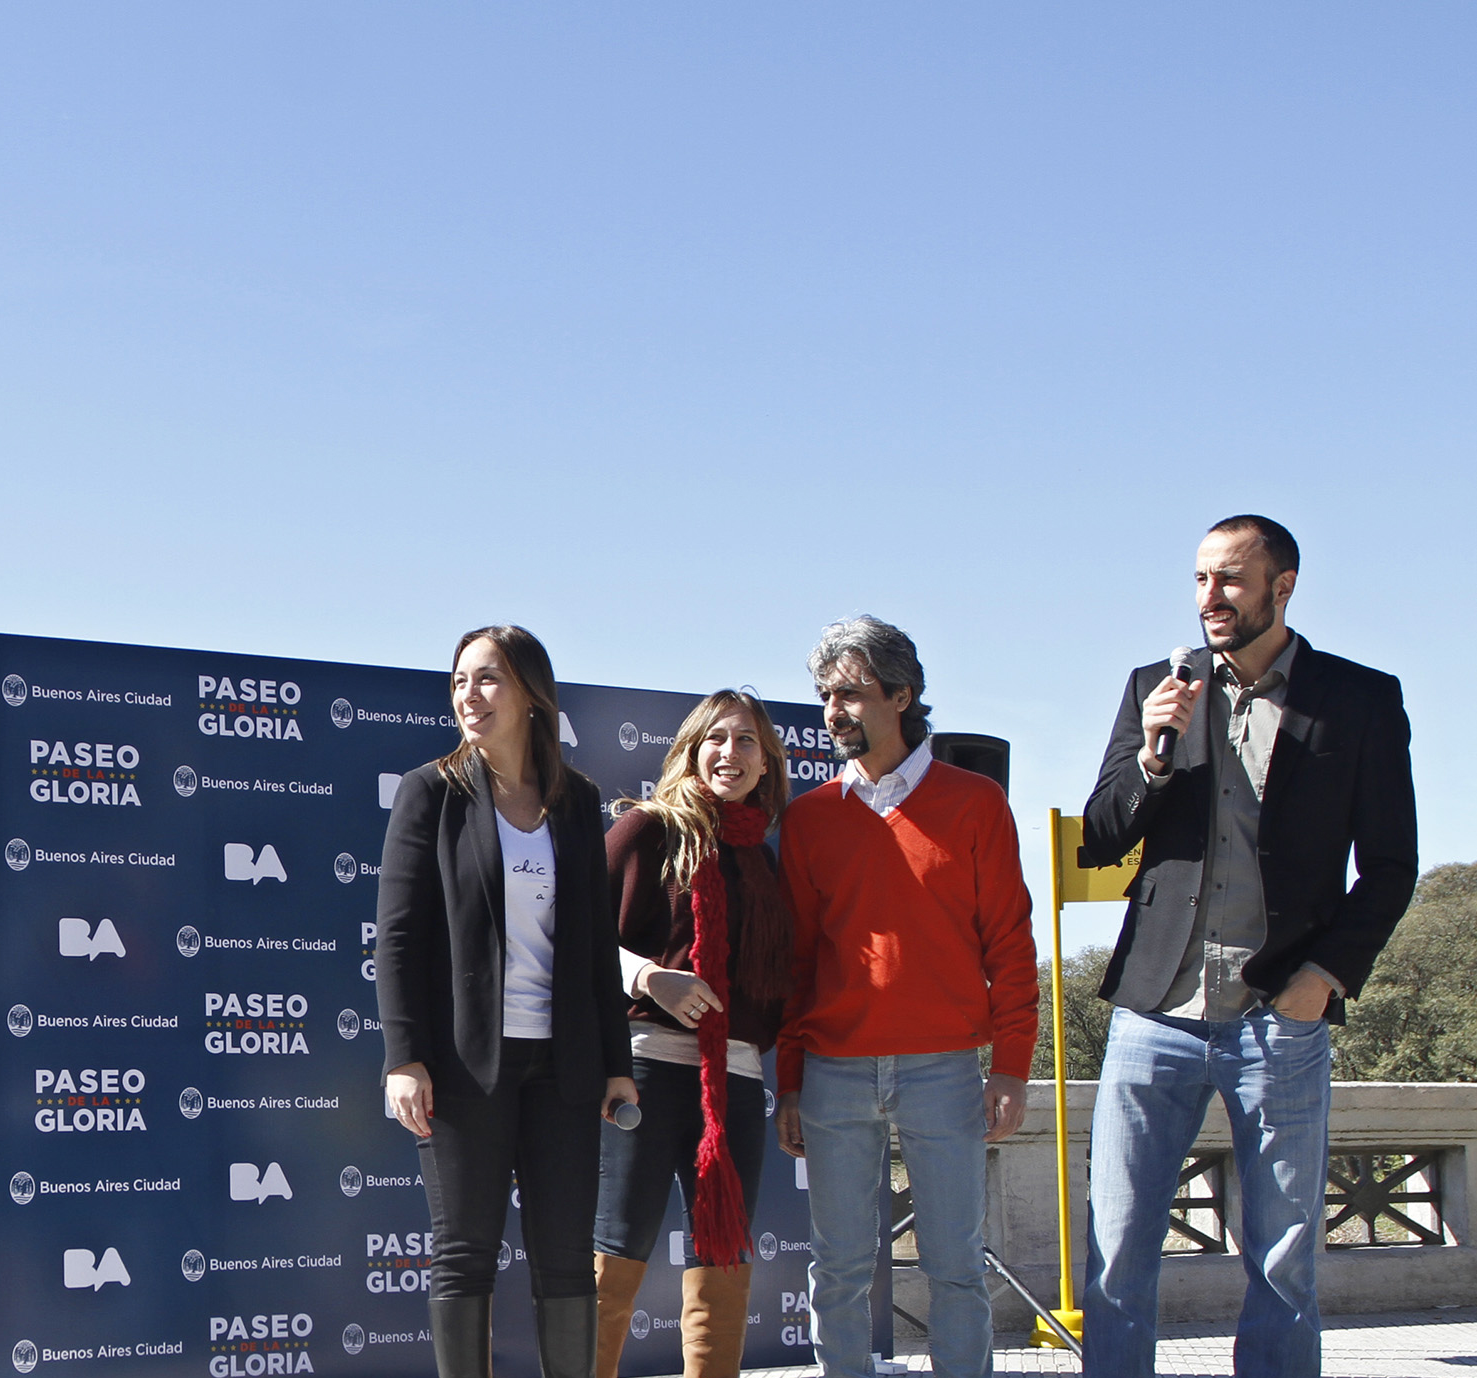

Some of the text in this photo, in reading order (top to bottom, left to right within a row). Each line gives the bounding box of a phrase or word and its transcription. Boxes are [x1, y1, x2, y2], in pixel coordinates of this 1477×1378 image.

[32, 685, 172, 707] Buenos Aires Ciudad
[198, 675, 302, 705] PASEO
[228, 702, 269, 714] DE LA
[198, 712, 304, 741] GLORIA
[357, 709, 458, 728] Buenos Aires Ciu
[641, 732, 675, 746] Bueno
[30, 739, 140, 769] PASEO
[793, 749, 825, 759] DE LA
[62, 767, 105, 780] DE LA
[29, 778, 142, 807] GLORIA
[201, 776, 333, 795] Buenos Aires Ciudad
[35, 849, 175, 867] Buenos Aires Ciudad
[224, 842, 288, 886] BA
[512, 859, 546, 875] chic
[58, 917, 127, 962] BA
[204, 935, 336, 952] Buenos Aires Ciudad
[205, 992, 308, 1018] PASEO
[37, 1014, 178, 1028] Buenos Aires Ciudad
[235, 1019, 276, 1030] DE LA
[204, 1031, 310, 1055] GLORIA
[35, 1068, 146, 1094] PASEO
[67, 1095, 111, 1107] DE LA
[207, 1096, 339, 1109] Buenos Aires Ciudad
[34, 1108, 147, 1133] GLORIA
[40, 1177, 181, 1194] Buenos Aires Ciudad
[229, 1161, 293, 1205] BA
[366, 1175, 412, 1187] Buenos
[366, 1232, 433, 1257] PASE
[63, 1247, 132, 1292] BA
[209, 1254, 342, 1271] Buenos Aires Ciudad
[395, 1258, 411, 1268] DE
[366, 1269, 432, 1293] GLOR
[210, 1313, 313, 1341] PASEO
[653, 1318, 681, 1329] Buen
[240, 1341, 280, 1353] DE LA
[368, 1332, 414, 1344] Buenos
[42, 1341, 183, 1362] Buenos Aires Ciudad
[209, 1351, 315, 1378] GLORIA
